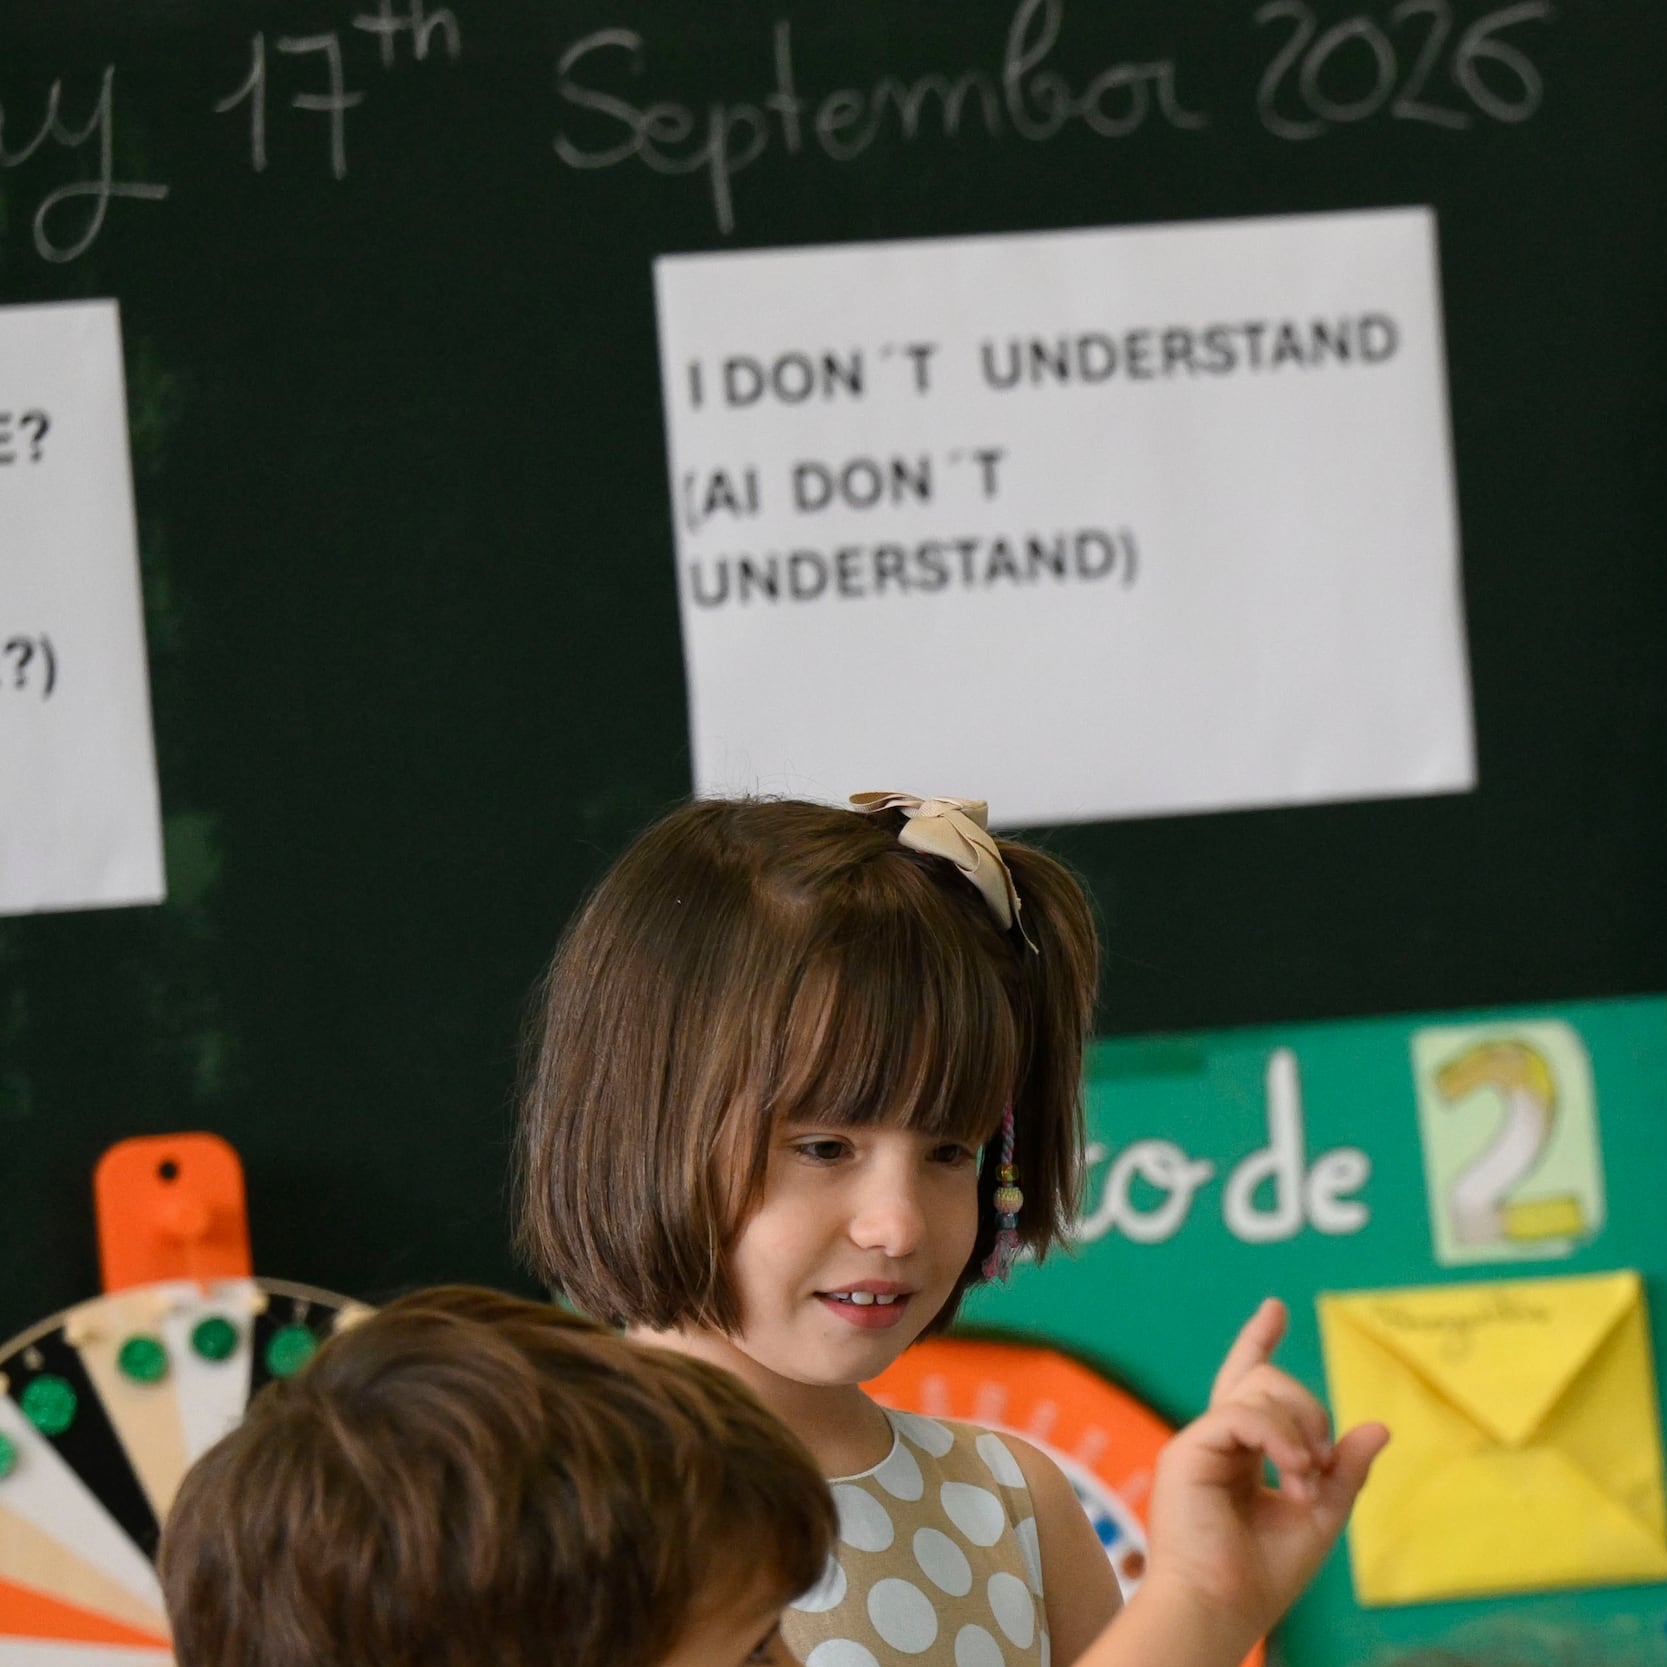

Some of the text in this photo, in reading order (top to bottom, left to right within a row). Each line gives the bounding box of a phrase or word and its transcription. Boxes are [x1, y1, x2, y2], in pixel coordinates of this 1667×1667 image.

[0, 62, 170, 262] y
[1256, 3, 1558, 140] 2026
[687, 361, 704, 411] I
[980, 312, 1402, 392] UNDERSTAND
[685, 468, 760, 533] (AI
[691, 528, 1140, 609] UNDERSTAND)
[1221, 1047, 1372, 1245] de
[1434, 1038, 1585, 1246] 2
